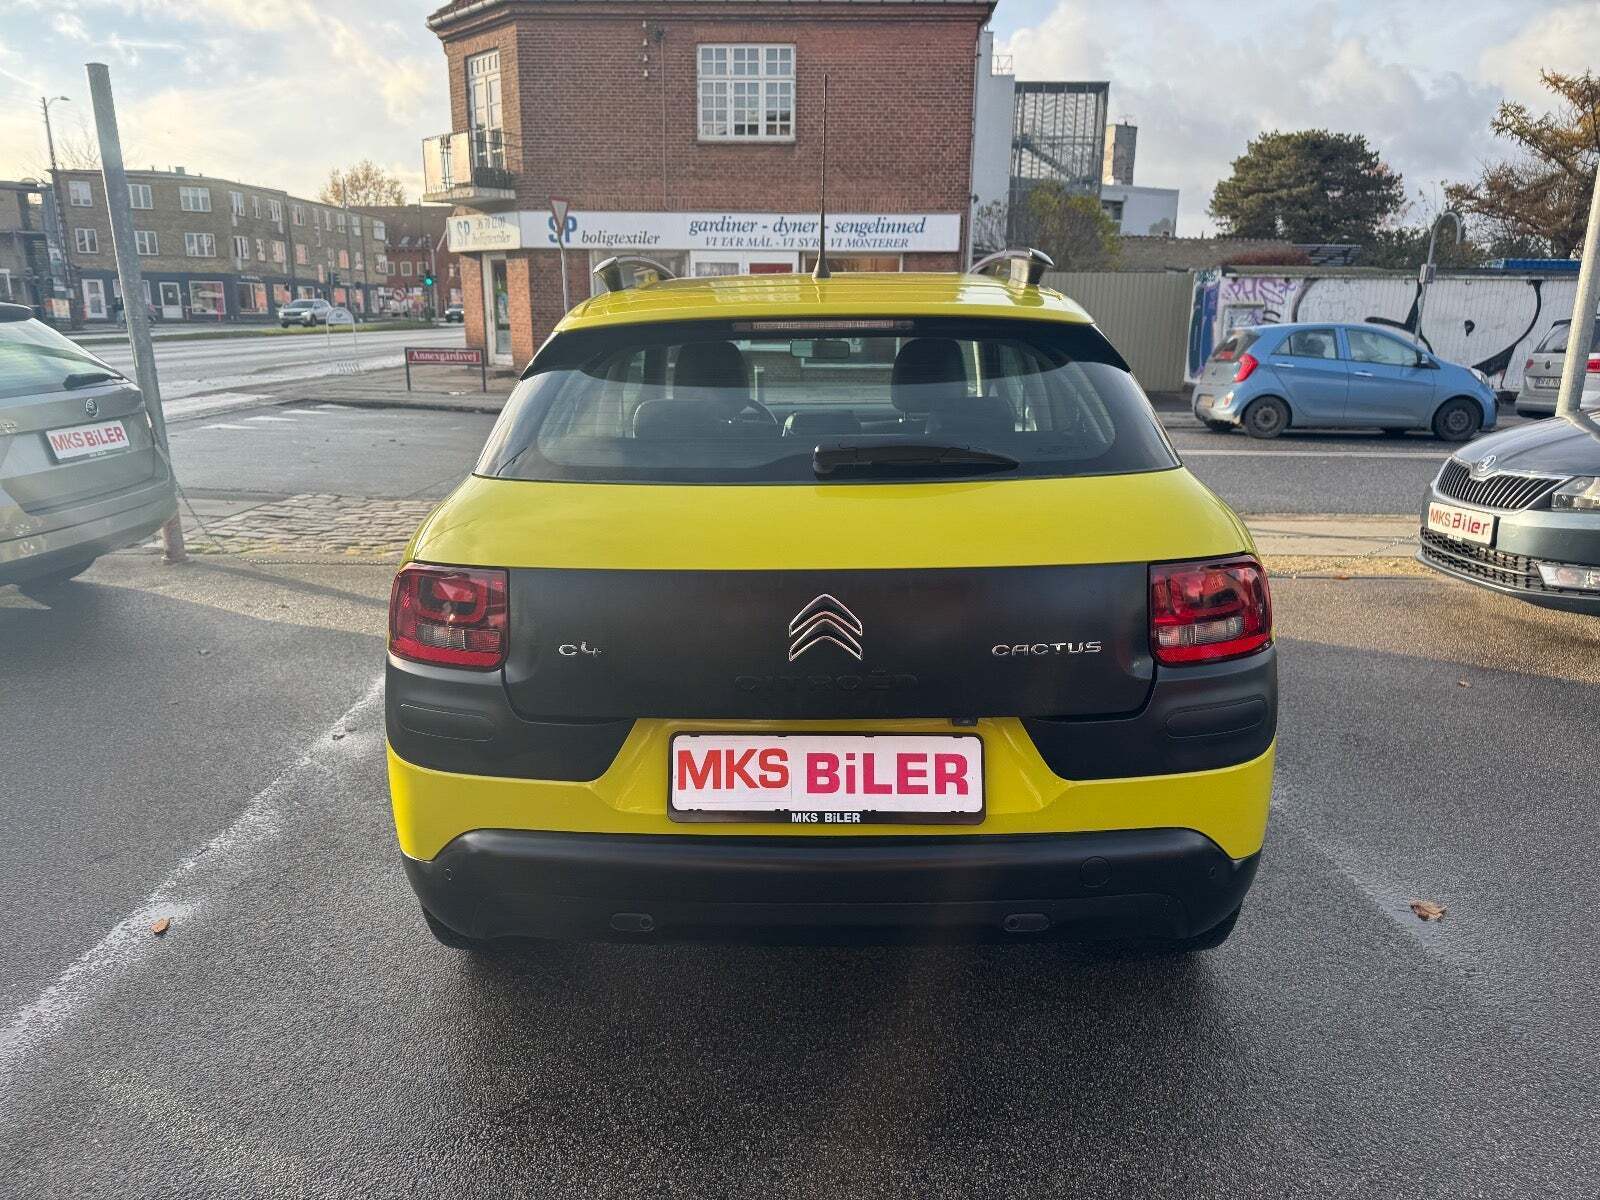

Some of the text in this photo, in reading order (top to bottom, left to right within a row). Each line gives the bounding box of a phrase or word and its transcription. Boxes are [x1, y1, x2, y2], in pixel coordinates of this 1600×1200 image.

[688, 215, 758, 236] gardiner
[773, 216, 819, 237] dyner
[834, 216, 927, 237] sengelinned
[581, 230, 660, 247] boligtextiler
[705, 236, 717, 248] VI
[783, 238, 795, 248] VI
[831, 238, 843, 248] VI
[845, 238, 909, 249] MONTERER
[51, 426, 125, 452] MKS BiLER
[1430, 508, 1490, 535] MKS Biler
[558, 641, 602, 658] C4
[991, 640, 1102, 657] CACTUS
[677, 748, 969, 795] MKS BiLER
[791, 812, 861, 823] MKS BiLER
